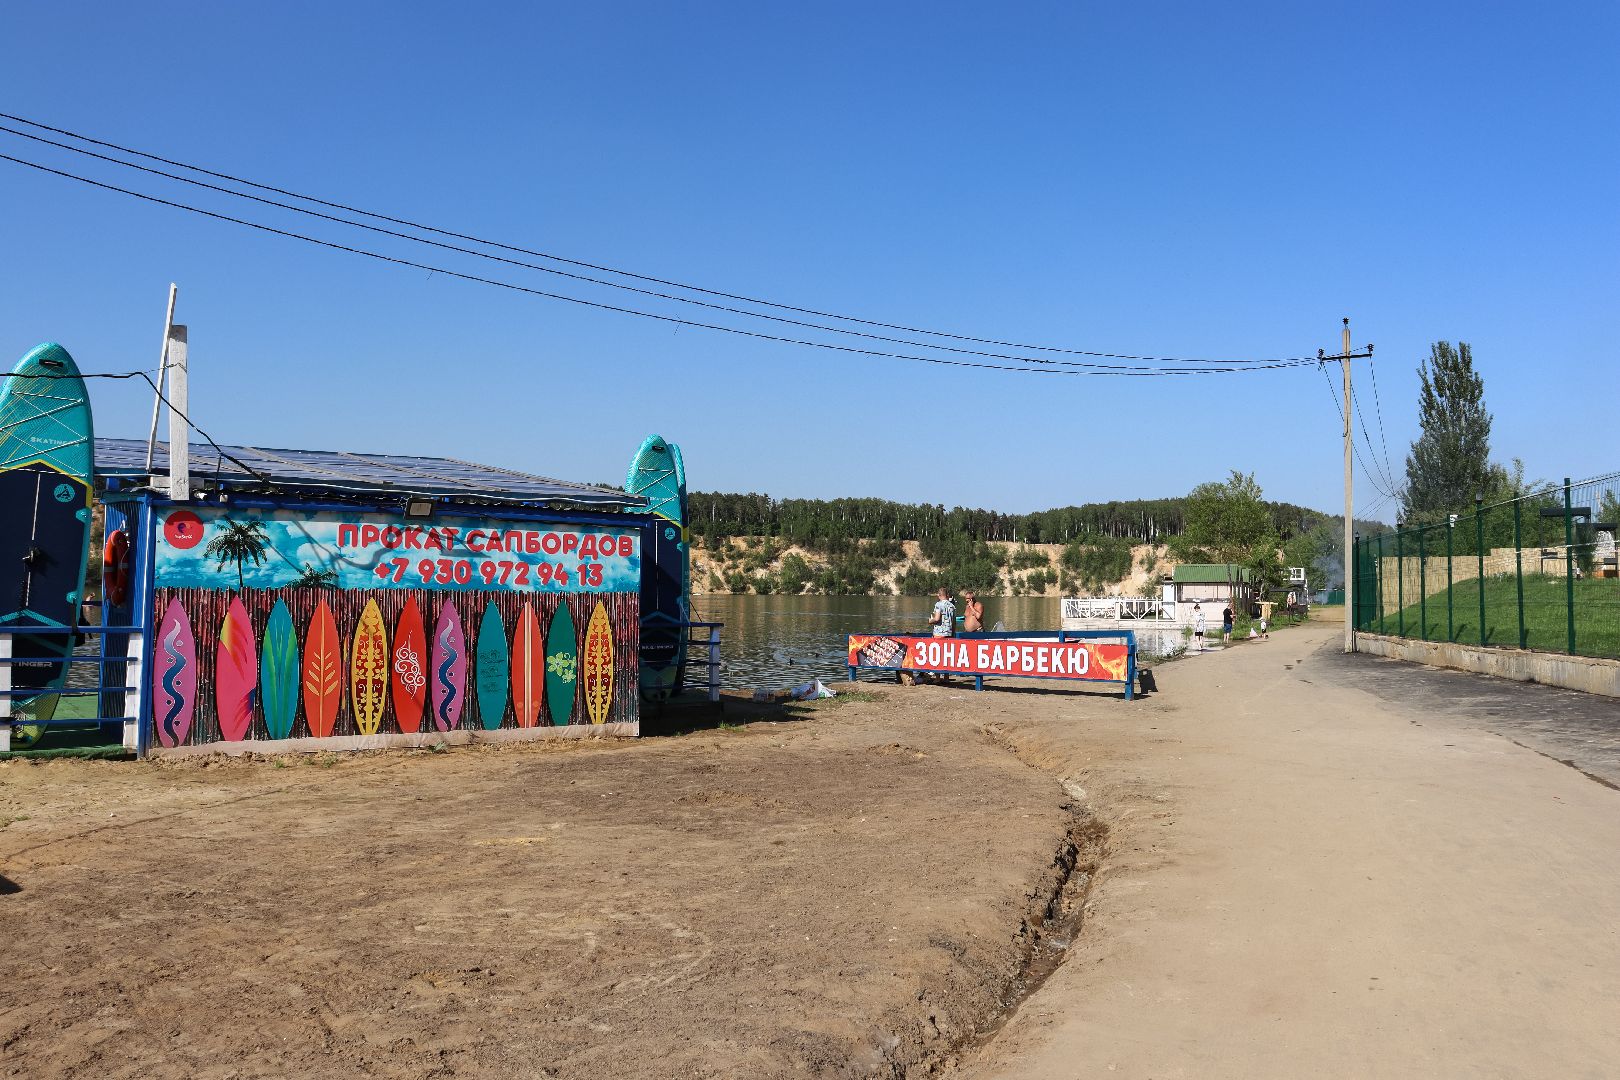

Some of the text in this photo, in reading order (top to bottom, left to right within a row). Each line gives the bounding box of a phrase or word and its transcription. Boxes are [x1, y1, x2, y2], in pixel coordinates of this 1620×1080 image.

[30, 436, 80, 448] SKATIN
[337, 523, 633, 560] ПРОКАТ САПБОРДОВ
[374, 558, 604, 587] +7 930 972 94 13
[914, 641, 1089, 675] ЗОНА БАРБЕКЮ
